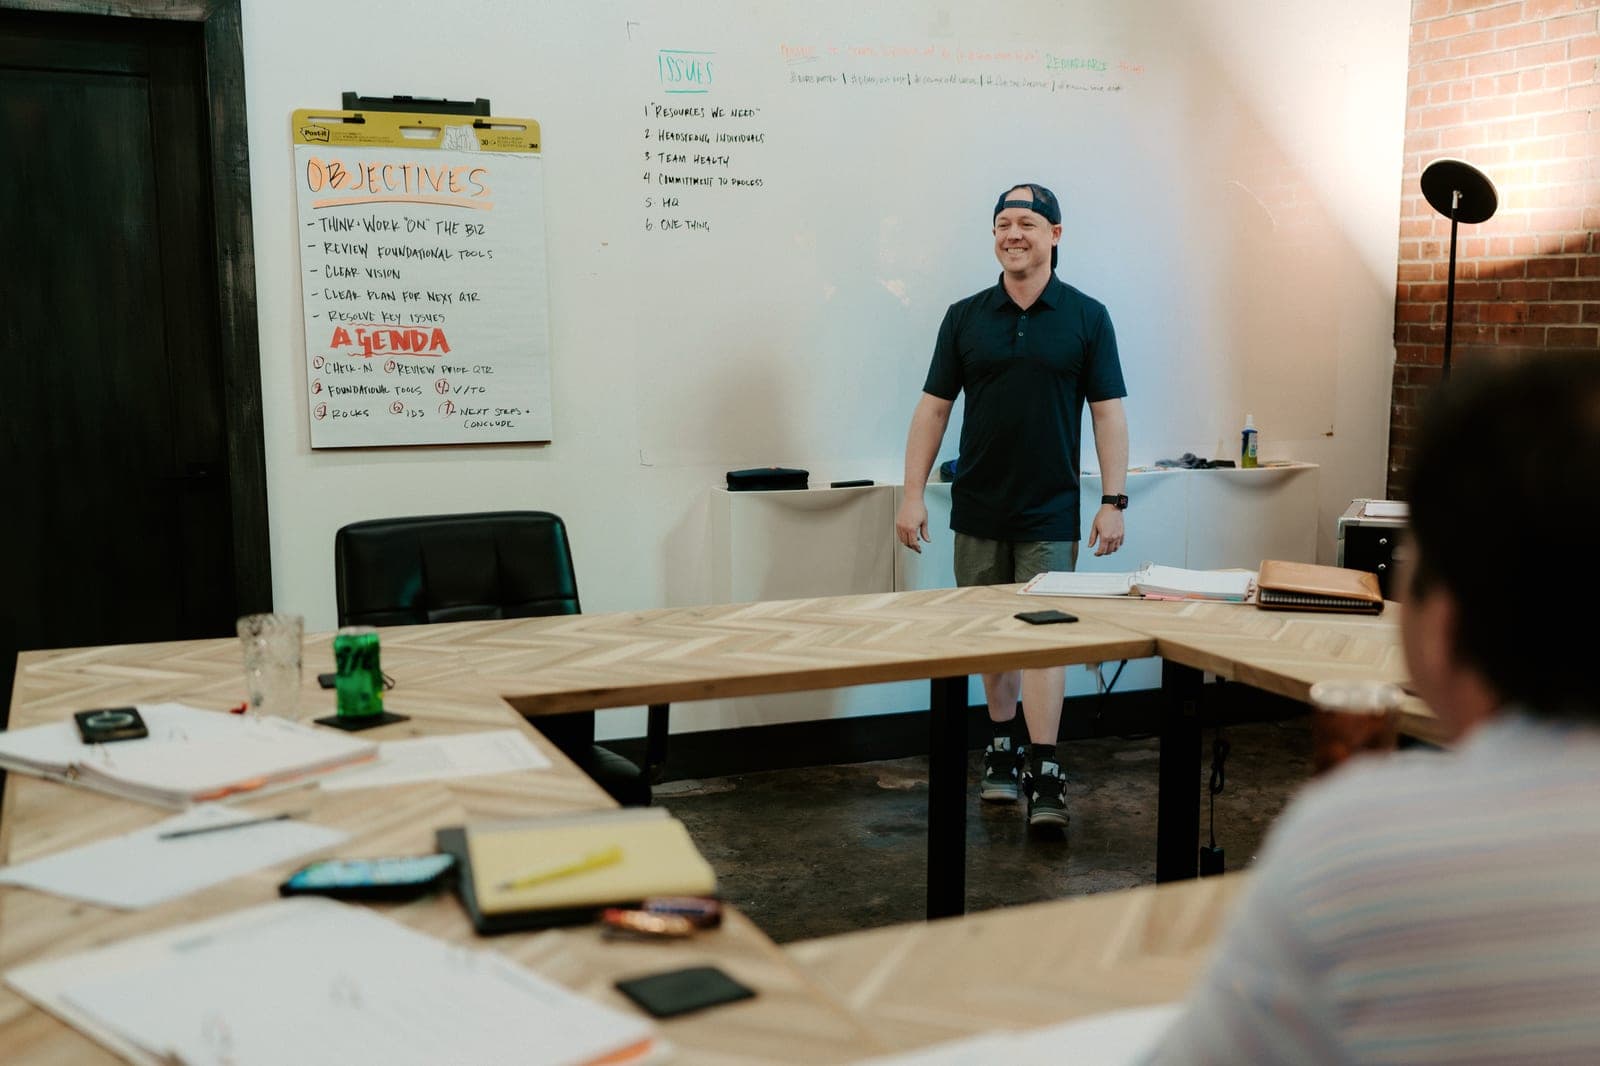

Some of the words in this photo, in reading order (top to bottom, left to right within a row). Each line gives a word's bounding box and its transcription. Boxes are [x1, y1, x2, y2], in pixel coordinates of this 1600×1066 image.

[658, 55, 713, 85] ISSUES
[711, 106, 726, 119] WE
[304, 129, 328, 137] Post-it
[644, 128, 650, 139] 2
[715, 132, 765, 144] INDIVIDUALS
[644, 151, 650, 161] 3
[657, 152, 687, 165] TEAM
[693, 154, 730, 167] HEALTH
[307, 158, 487, 198] OBJECTIVES
[643, 171, 651, 184] 4
[718, 176, 728, 186] TO
[731, 178, 764, 187] PROCESS
[662, 197, 680, 208] HQ
[318, 215, 355, 233] THINK
[363, 214, 400, 233] WORK
[436, 220, 460, 236] THE
[465, 223, 486, 238] BIZ
[660, 218, 683, 232] ONE
[685, 220, 710, 233] THING
[324, 241, 368, 259] REVIEW
[377, 244, 453, 261] FOUNDATIONAL
[458, 249, 493, 261] TOOLS
[325, 264, 360, 279] CLEAR
[365, 267, 401, 280] VISION
[324, 288, 361, 301] CLEAR
[367, 289, 396, 301] PLAN
[402, 290, 421, 303] FOR
[427, 290, 453, 305] NEXT
[459, 291, 481, 303] QTR
[328, 310, 376, 322] RESOLVE
[381, 310, 401, 325] KEY
[409, 313, 446, 324] ISSUES
[330, 326, 451, 358] AGENDA
[397, 361, 436, 376] REVIEW
[441, 364, 470, 375] PRIOR
[472, 365, 494, 375] QTR
[328, 384, 390, 397] FOUNDATIONAL
[395, 386, 423, 396] TOOLS
[332, 409, 369, 419] ROCKS
[406, 409, 426, 418] IDS
[460, 407, 490, 416] NEXT
[494, 408, 522, 417] STEPS
[463, 419, 515, 429] CONCLUDE
